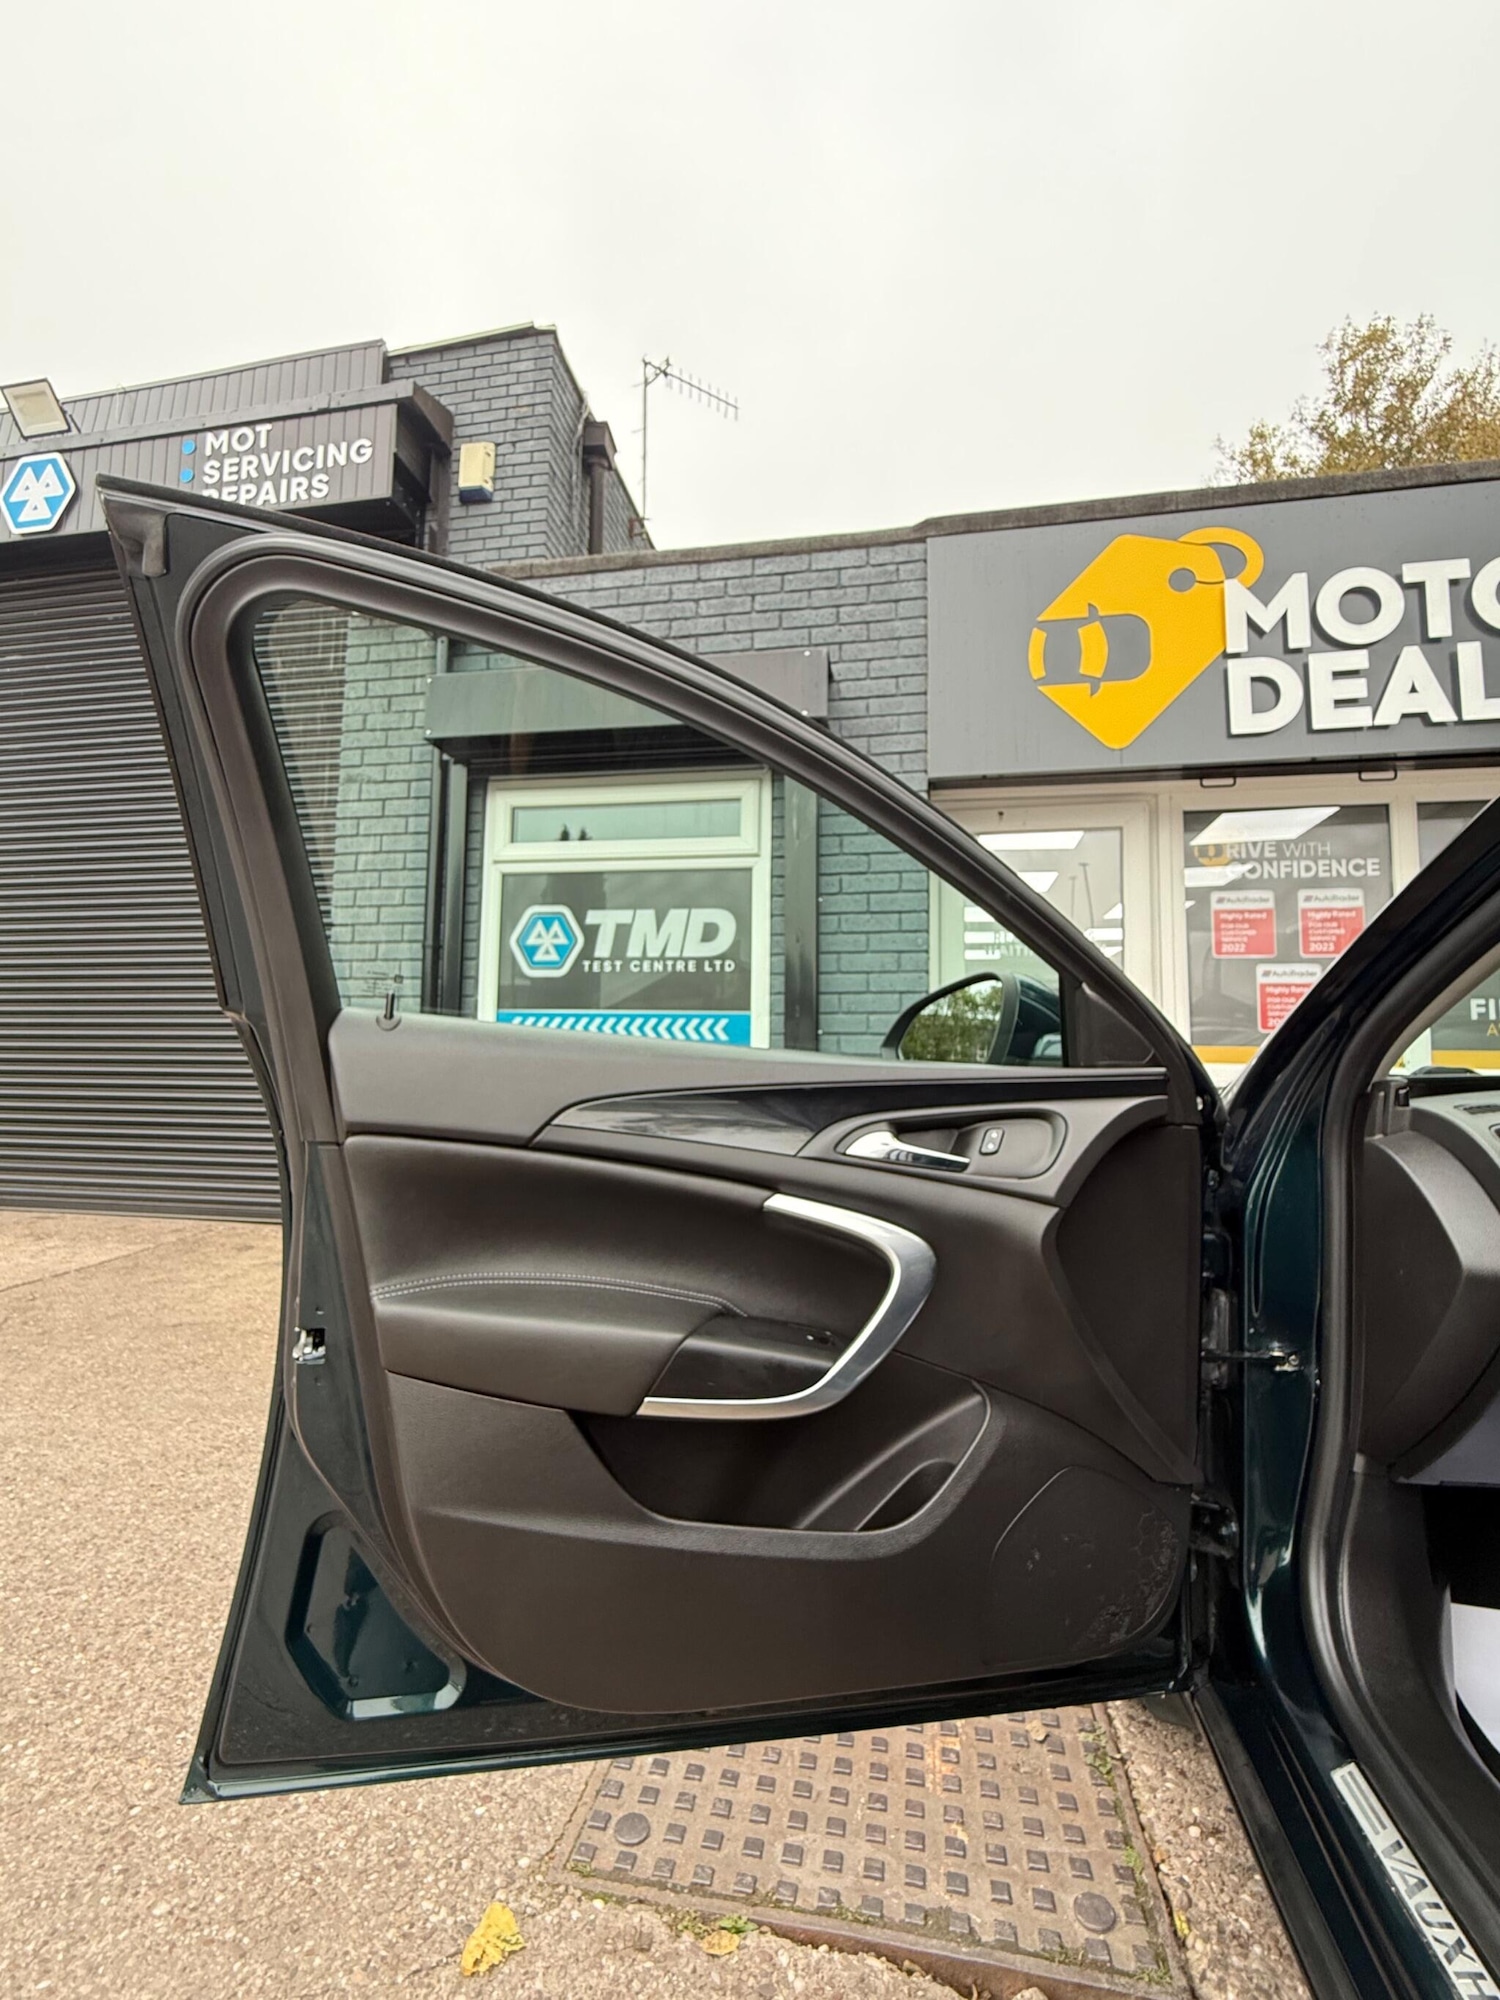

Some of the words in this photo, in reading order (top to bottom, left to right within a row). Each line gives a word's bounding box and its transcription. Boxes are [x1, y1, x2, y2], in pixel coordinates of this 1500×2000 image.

[205, 423, 272, 457] MOT
[202, 438, 373, 485] SERVICING
[1227, 641, 1500, 736] DEAL
[1283, 841, 1331, 858] WITH
[1226, 858, 1381, 880] CONFIDENCE
[585, 908, 737, 958] TMD
[1221, 942, 1246, 953] 2022
[1309, 942, 1335, 952] 2023
[582, 960, 623, 973] TEST
[629, 960, 697, 973] CENTRE
[703, 959, 736, 972] LTD
[1470, 998, 1500, 1020] FI
